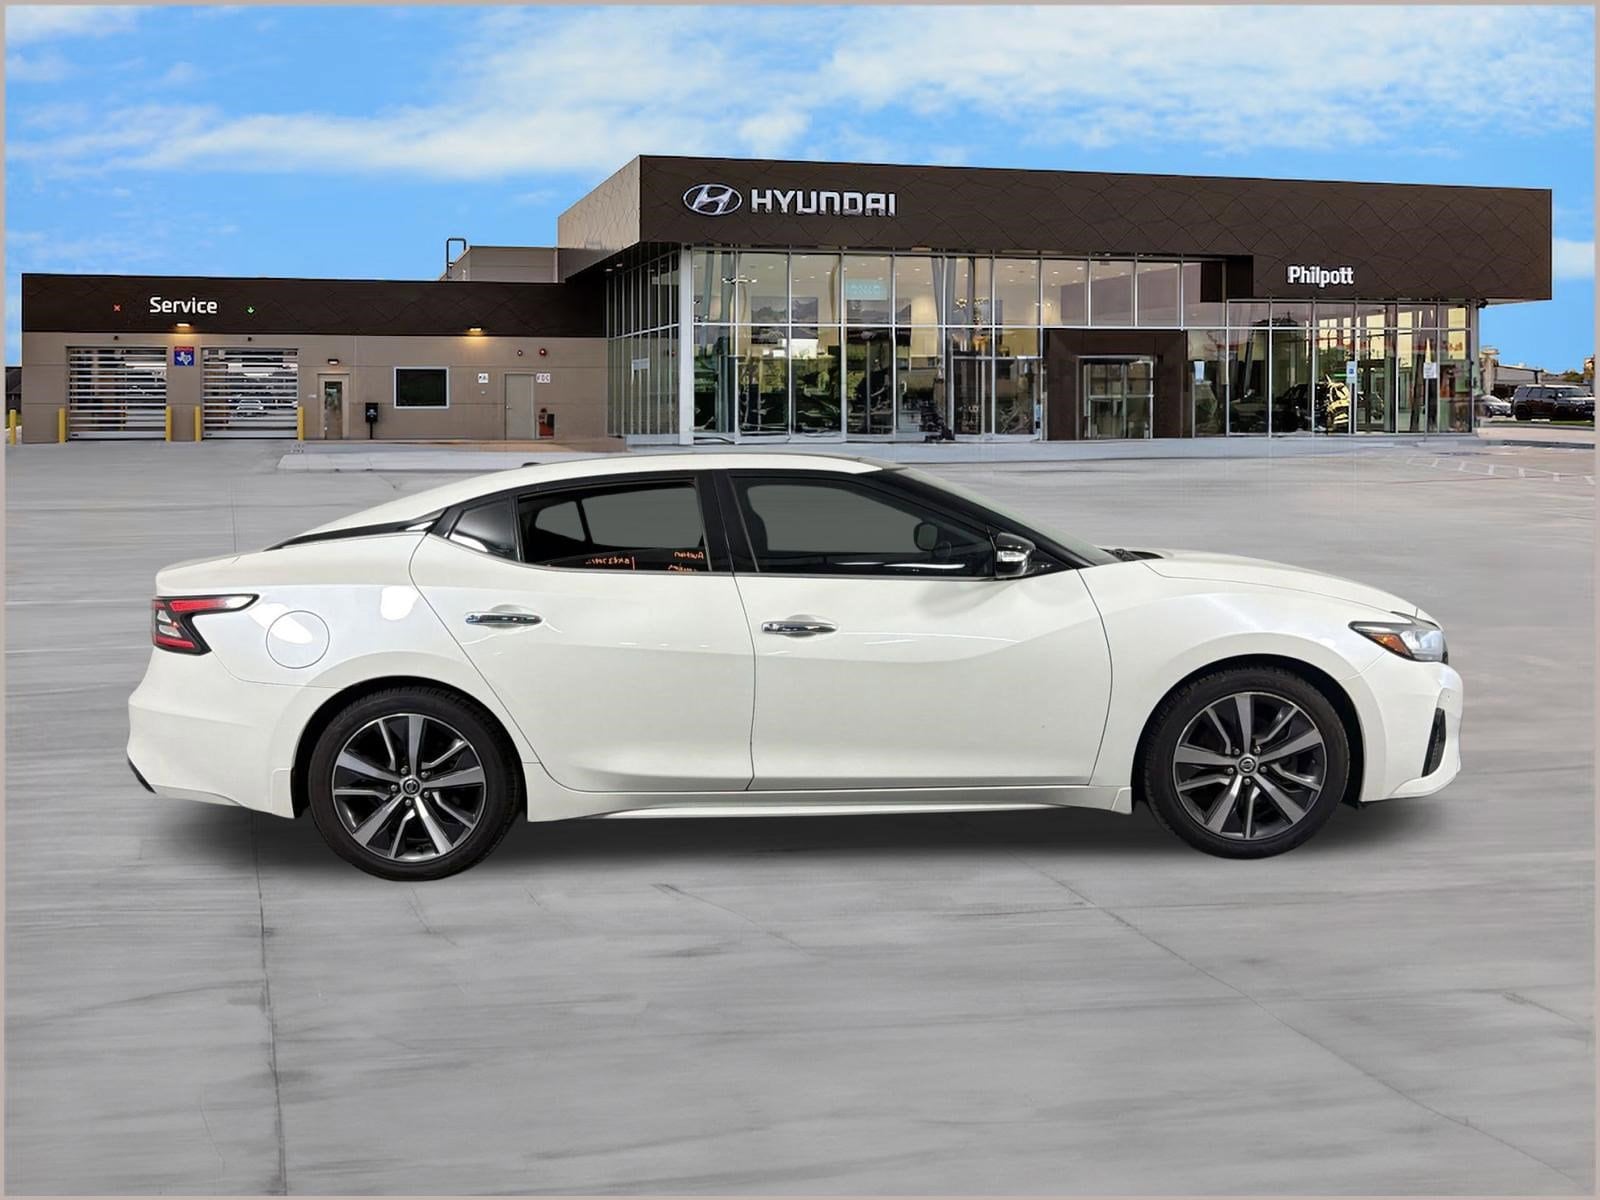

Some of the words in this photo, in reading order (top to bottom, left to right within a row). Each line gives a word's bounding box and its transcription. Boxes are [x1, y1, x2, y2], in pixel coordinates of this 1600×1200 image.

[751, 189, 896, 216] HYUNDAI
[1287, 265, 1354, 288] Philpott
[149, 296, 218, 314] Service
